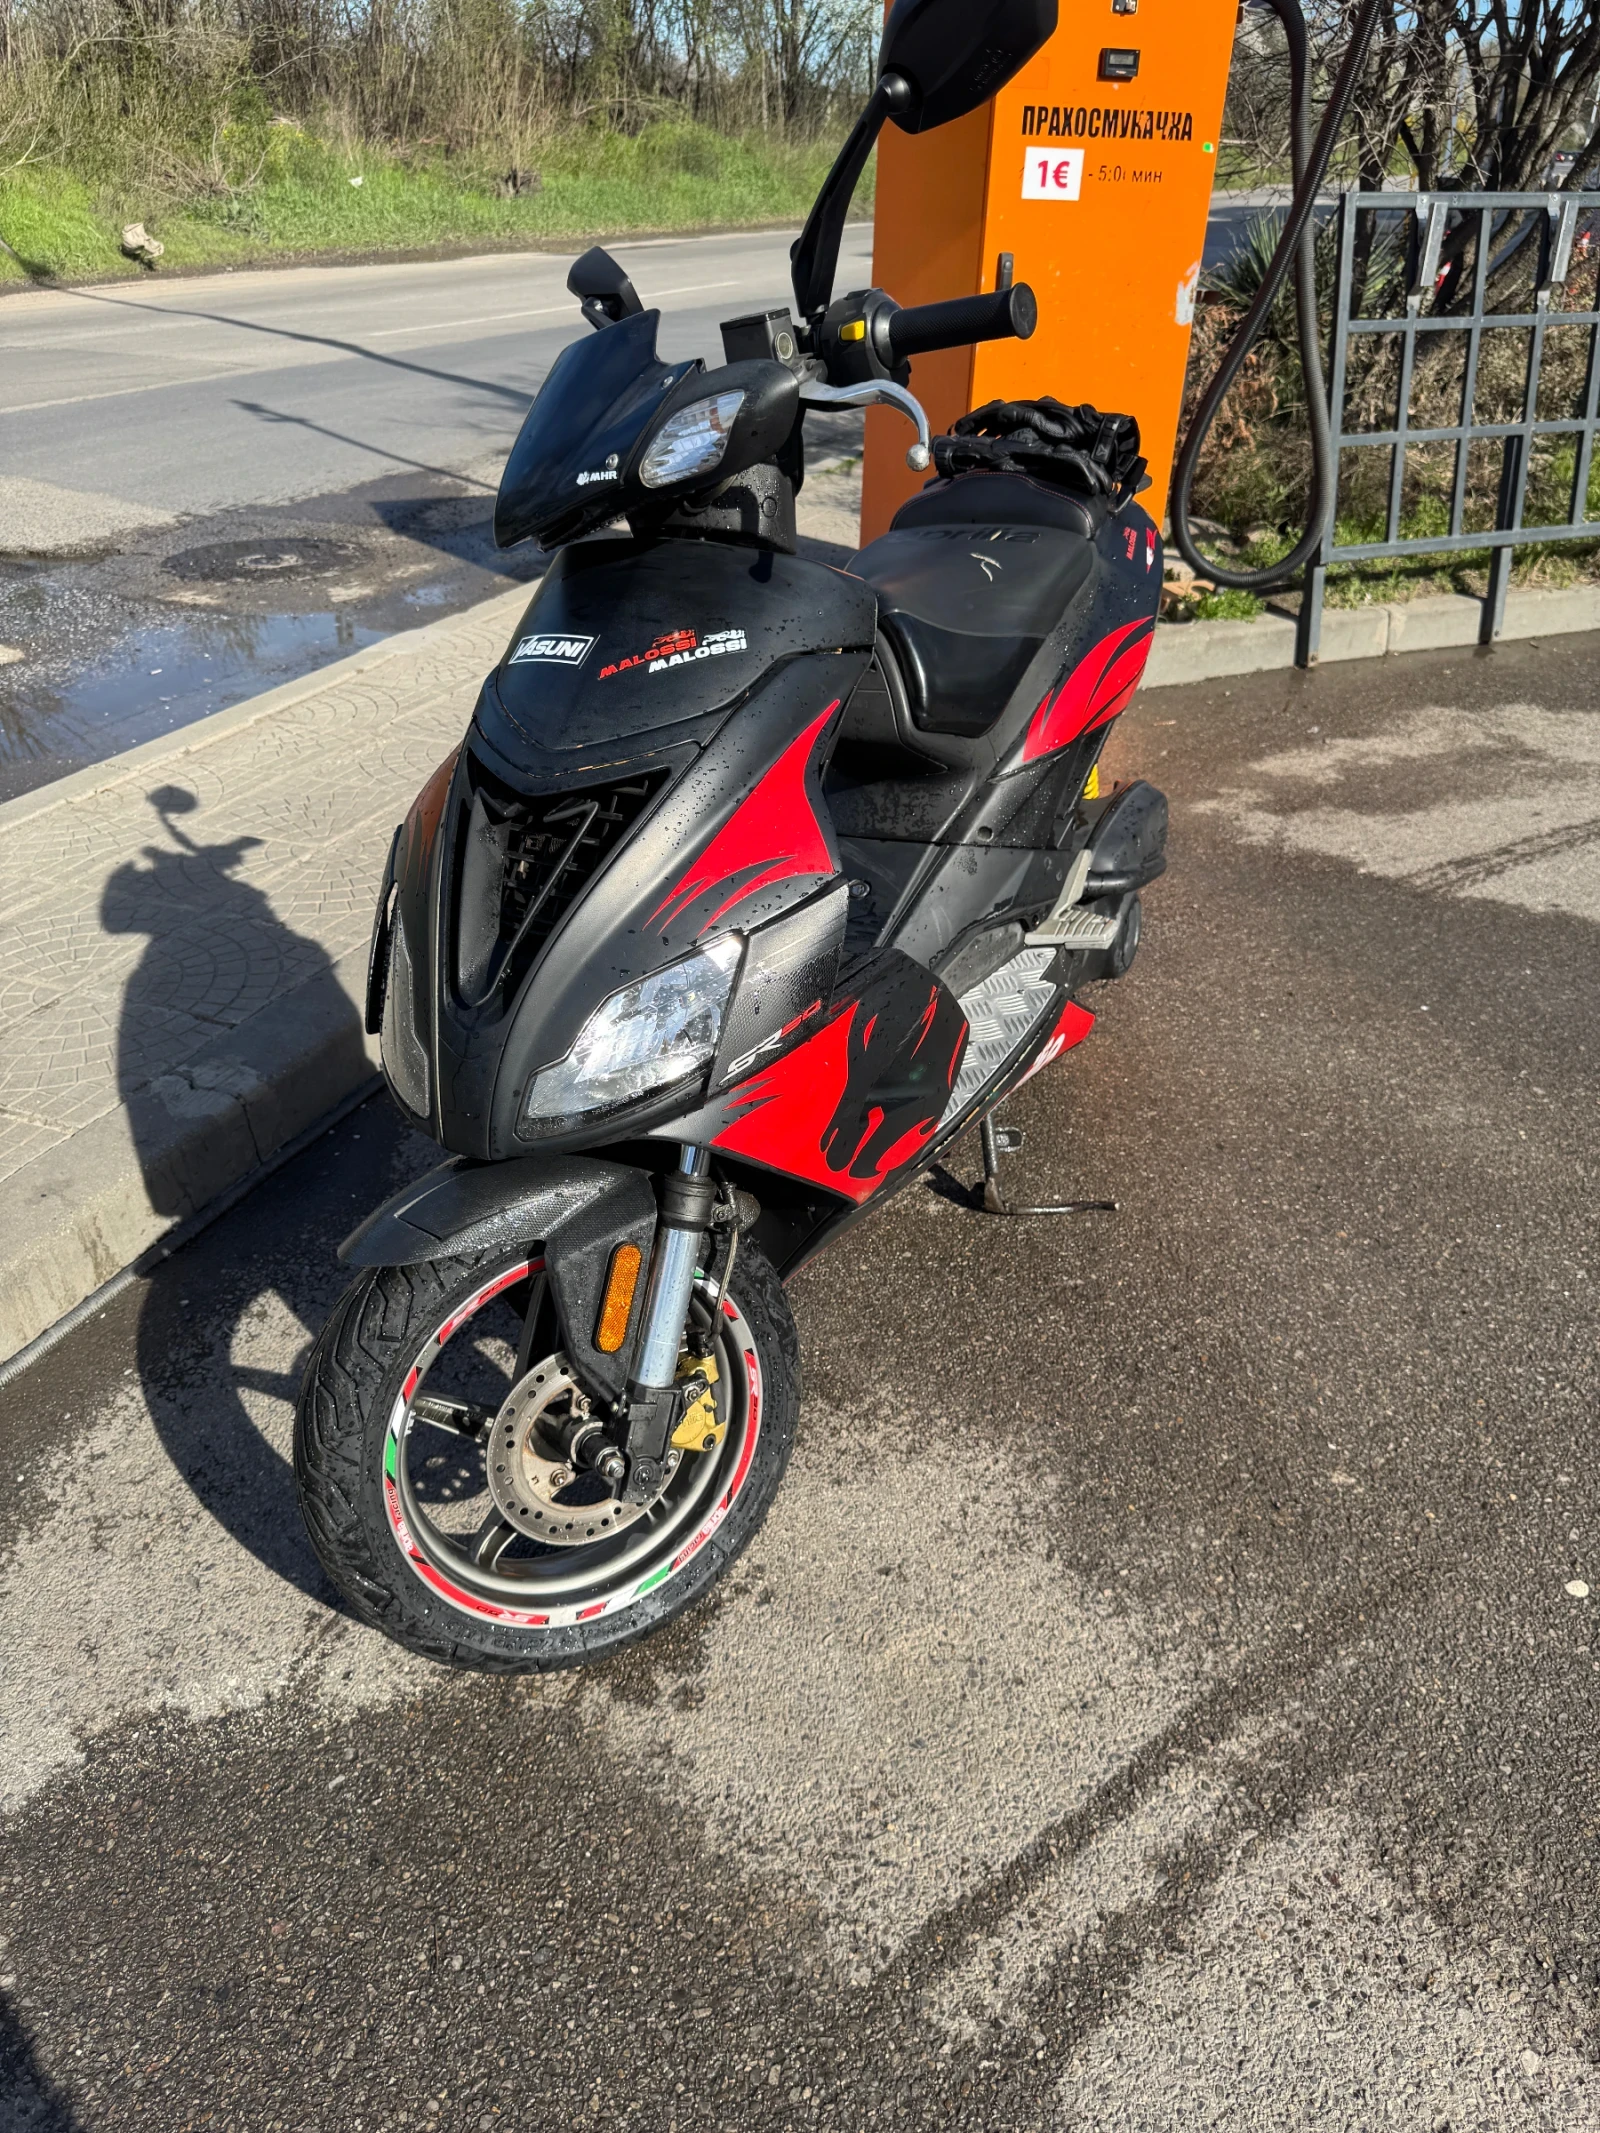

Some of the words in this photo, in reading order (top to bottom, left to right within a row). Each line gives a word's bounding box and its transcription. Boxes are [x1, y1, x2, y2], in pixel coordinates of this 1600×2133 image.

[1037, 160, 1070, 189] 1€
[1131, 170, 1163, 183] мин
[589, 470, 619, 482] MHR
[513, 635, 586, 661] VASUNI
[599, 637, 697, 679] MALOSSI
[648, 638, 748, 674] MALOSSI
